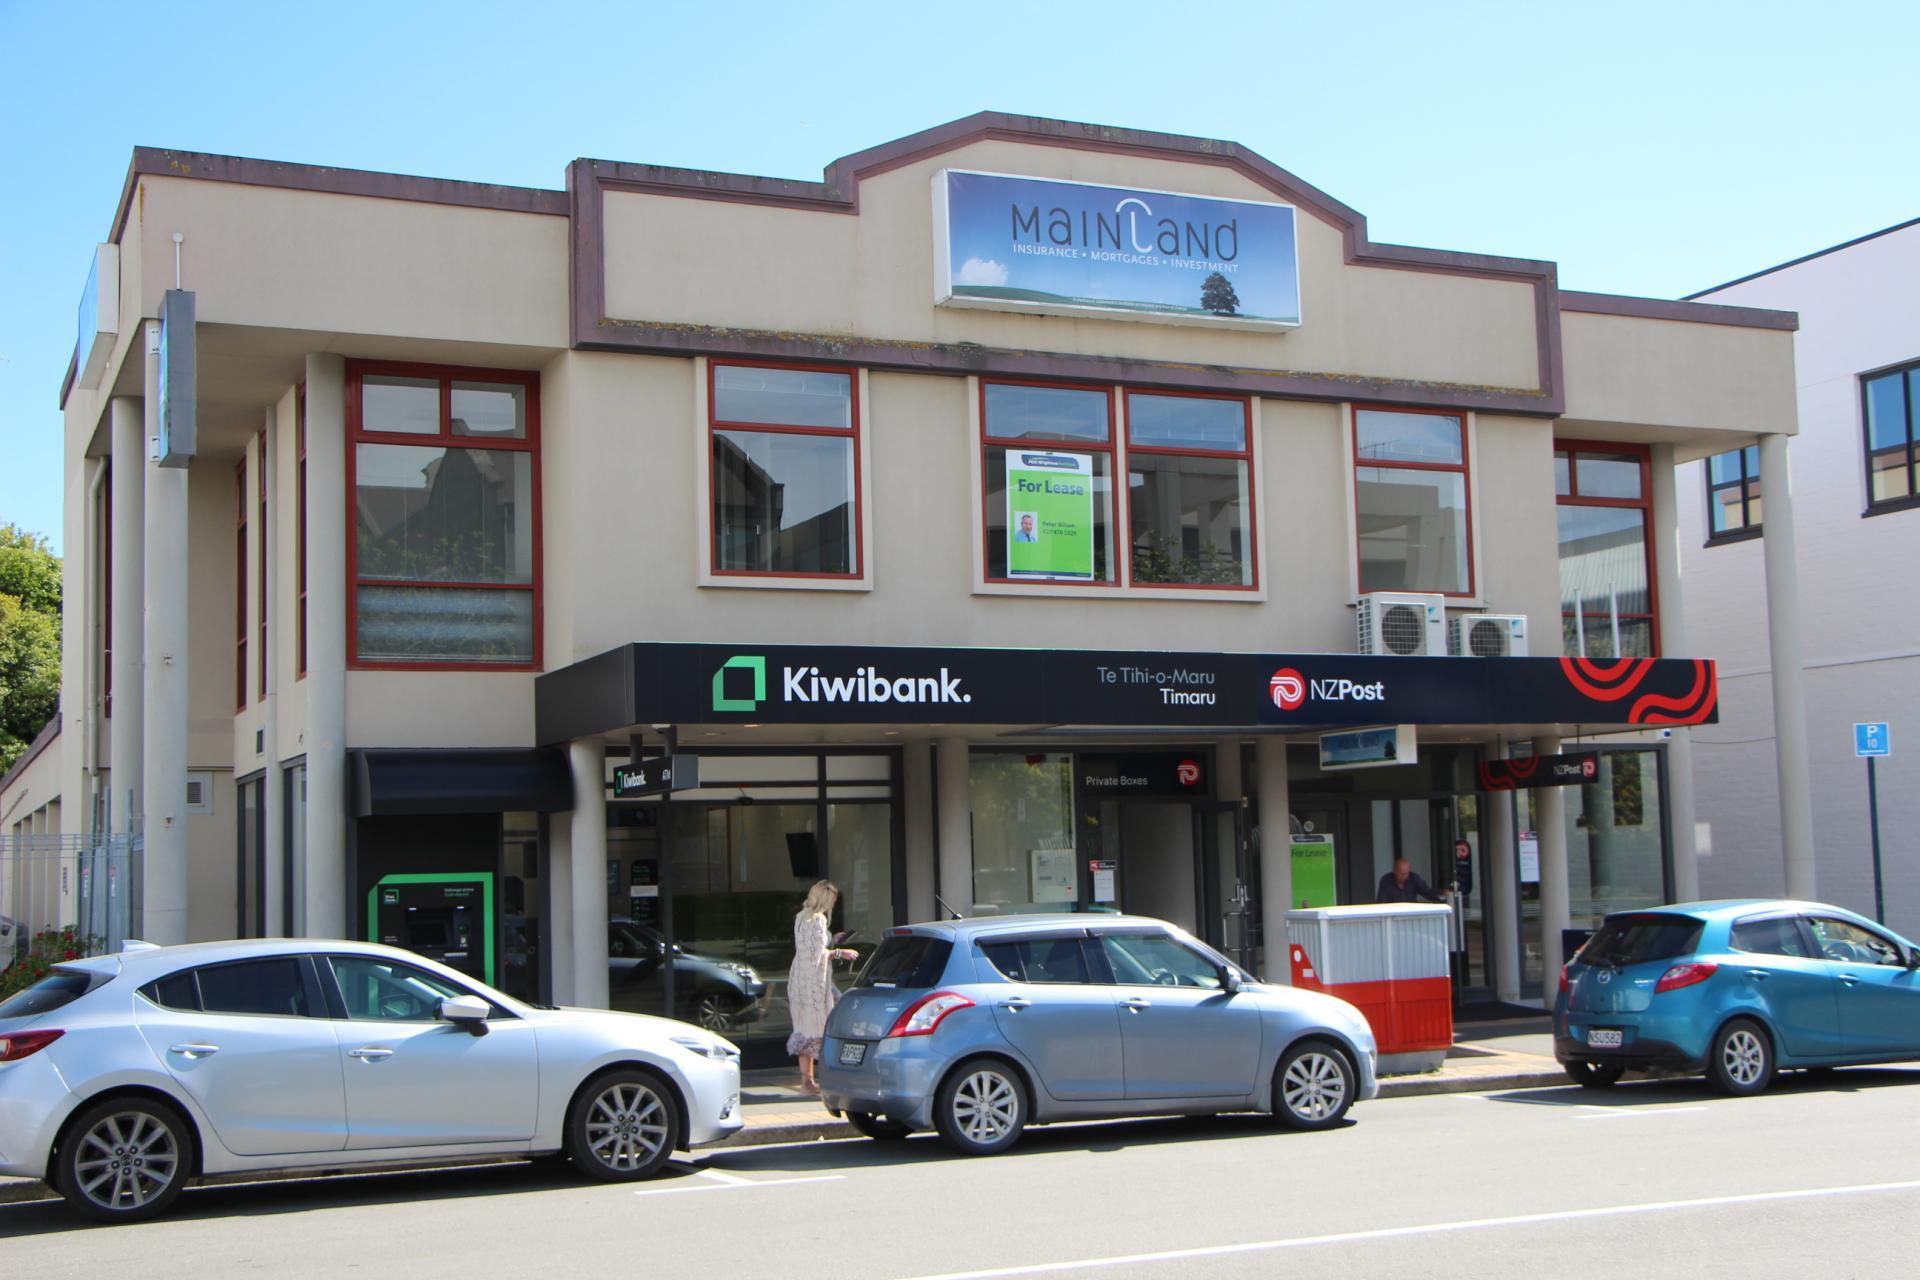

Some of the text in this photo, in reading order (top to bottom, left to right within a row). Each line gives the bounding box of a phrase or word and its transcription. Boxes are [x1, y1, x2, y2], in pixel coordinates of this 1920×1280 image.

[1013, 243, 1239, 274] INSURANCE MORTGAGES INVESTMENT
[1018, 478, 1083, 495] For Lease
[783, 666, 972, 703] Kiwibank.
[1097, 666, 1215, 685] Te Tihi-o-Maru
[1160, 687, 1216, 705] Timaru
[1310, 679, 1385, 701] NZPost
[1867, 725, 1878, 738] P
[1867, 738, 1878, 749] 10
[1085, 776, 1148, 787] Private Boxes
